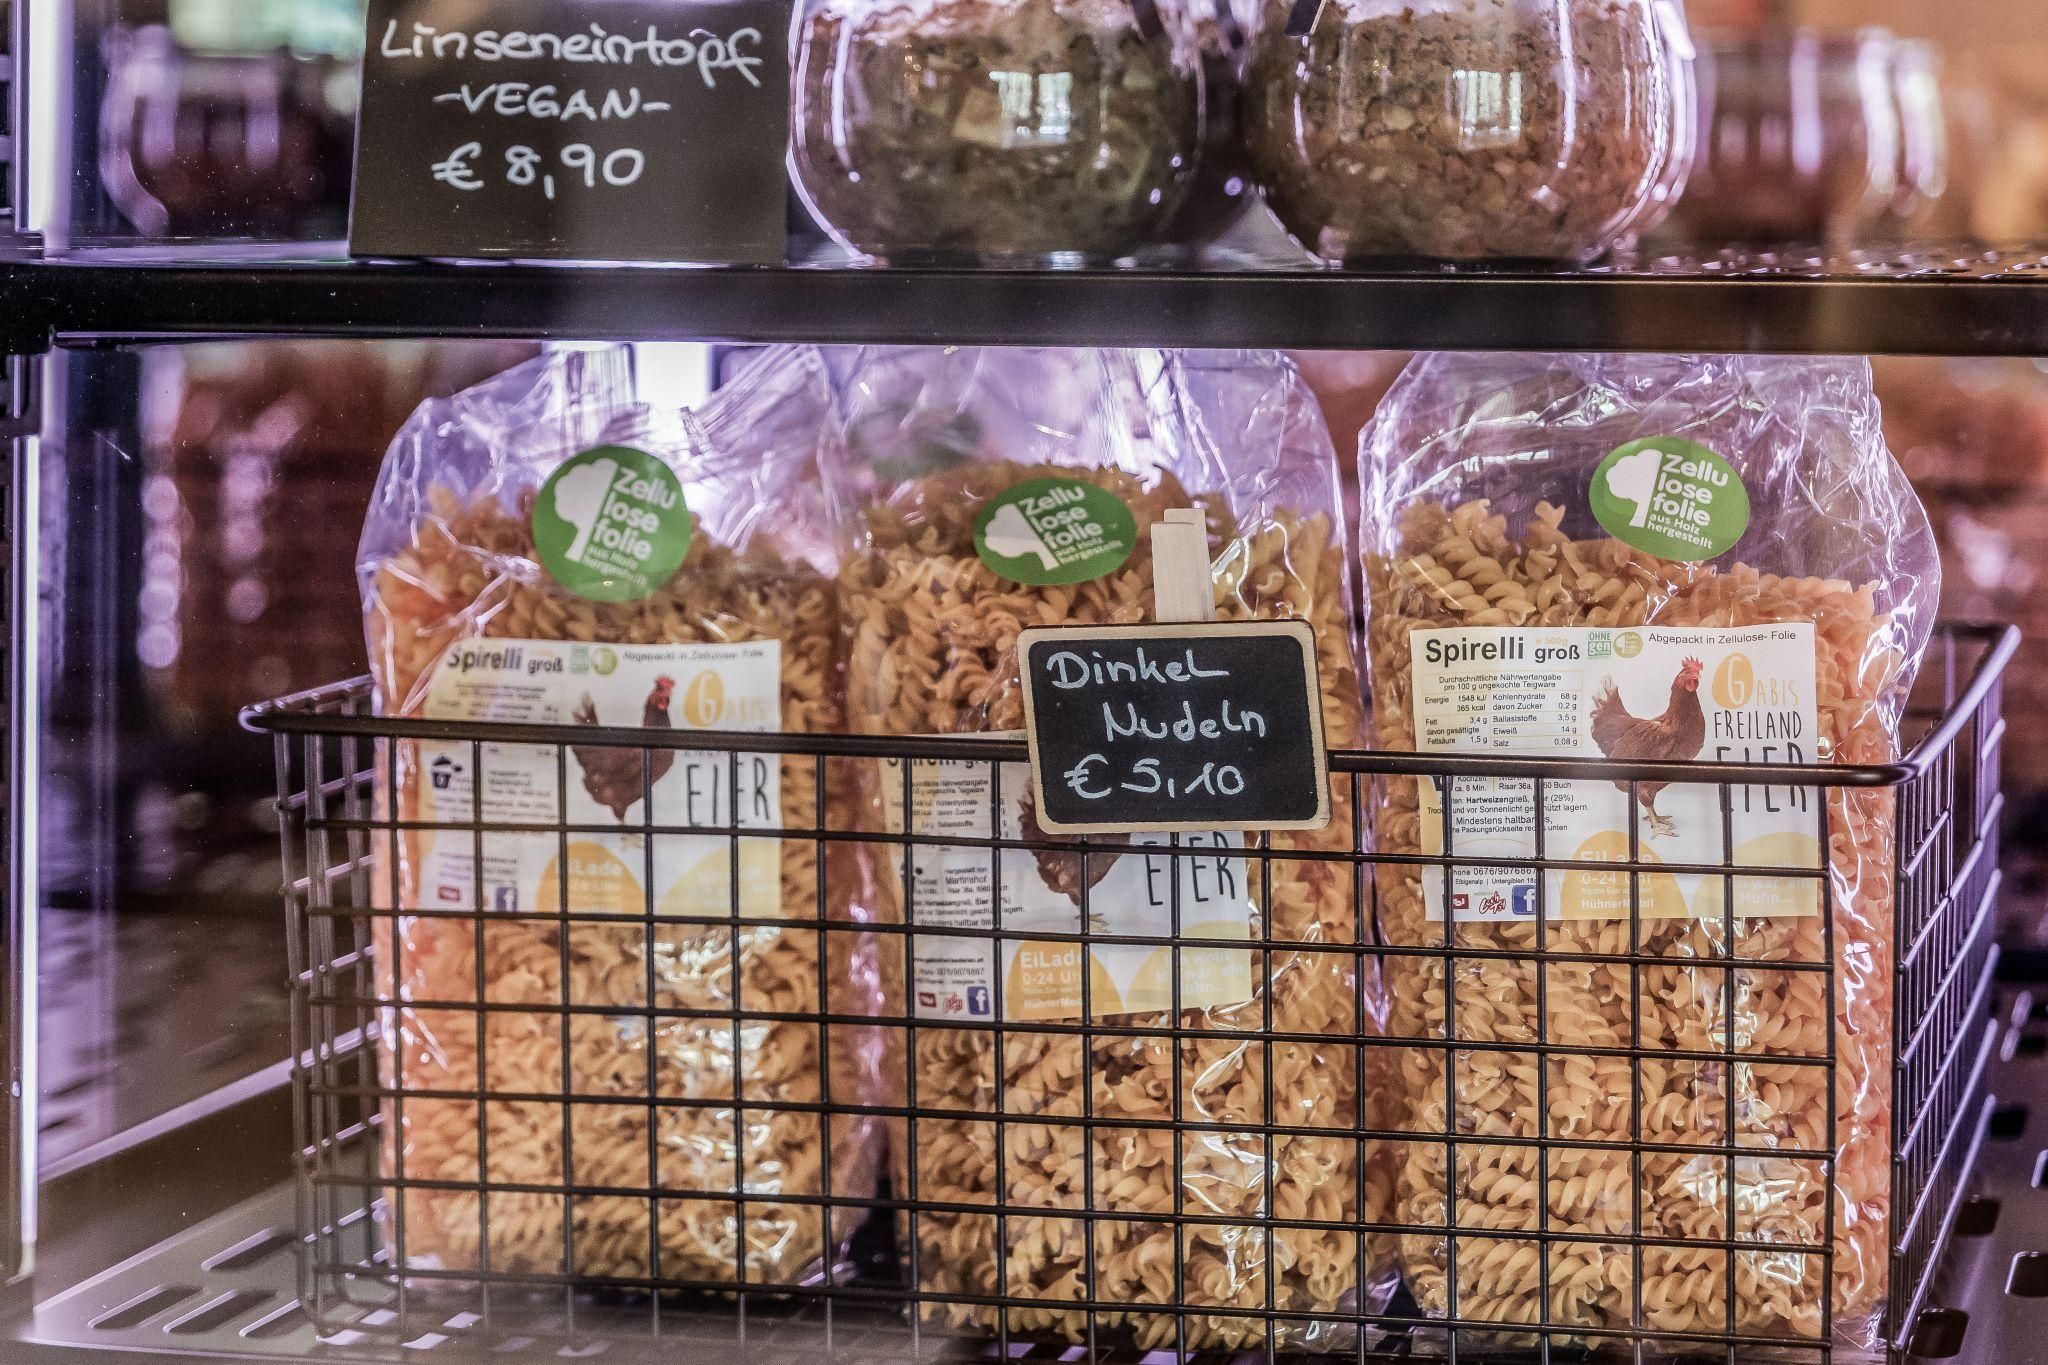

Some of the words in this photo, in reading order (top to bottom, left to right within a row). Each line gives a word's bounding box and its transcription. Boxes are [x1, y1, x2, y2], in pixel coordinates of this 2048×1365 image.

[380, 19, 763, 88] Linseneintopf
[431, 141, 485, 190] €
[505, 143, 645, 199] 8,90
[1662, 453, 1729, 487] Zellu
[612, 466, 678, 510] Zellu
[1657, 471, 1713, 504] lose
[1018, 485, 1086, 517] Zellu
[602, 491, 660, 534] lose
[1653, 492, 1711, 527] folie
[1029, 506, 1088, 533] lose
[1650, 513, 1671, 525] aus
[1674, 519, 1700, 535] Holz
[593, 517, 653, 561] folie
[1043, 522, 1103, 549] folie
[1647, 520, 1713, 549] hergestellt
[1589, 632, 1611, 641] OHNE
[1648, 632, 1703, 645] Abgepackt
[1706, 634, 1715, 644] in
[1718, 633, 1768, 644] Zellulose-
[1771, 630, 1796, 640] Folie
[448, 645, 523, 673] Spirelli
[1425, 636, 1524, 668] Spirelli
[1534, 644, 1580, 664] groß
[1047, 647, 1229, 689] Dinkel
[1439, 675, 1498, 684] Durchschnittliche
[1500, 673, 1562, 682] Nährwertangabe
[1444, 684, 1455, 692] pro
[1479, 681, 1521, 690] ungekochte
[1522, 680, 1556, 689] Teigware
[1425, 696, 1450, 705] Energie
[1493, 693, 1546, 702] Kohlenhydrate
[1456, 704, 1470, 712] 365
[1493, 702, 1515, 711] davon
[1516, 702, 1543, 711] Zucker
[1102, 700, 1266, 742] Nudeln
[1469, 716, 1481, 724] 3,4
[1493, 715, 1537, 723] Ballaststoffe
[1557, 714, 1570, 722] 3,5
[1713, 709, 1801, 740] FREILAND
[1446, 726, 1480, 736] gesättigte
[1493, 727, 1518, 735] Eiweiß
[1470, 736, 1481, 744] 1,5
[1554, 738, 1570, 746] 0,08
[1063, 754, 1113, 799] €
[1121, 758, 1245, 798] 5,10
[1472, 784, 1487, 792] Min.
[1499, 782, 1517, 790] Risar
[1553, 781, 1572, 789] Buch
[1550, 794, 1574, 803] (29%)
[1452, 806, 1465, 814] und
[1480, 805, 1523, 813] Sonnenlicht
[1456, 815, 1502, 825] Mindestens
[1505, 815, 1535, 824] haltbar
[1461, 825, 1523, 834] Packungsrückseite
[1143, 831, 1236, 906] EER
[1582, 899, 1654, 909] HühnerMbil
